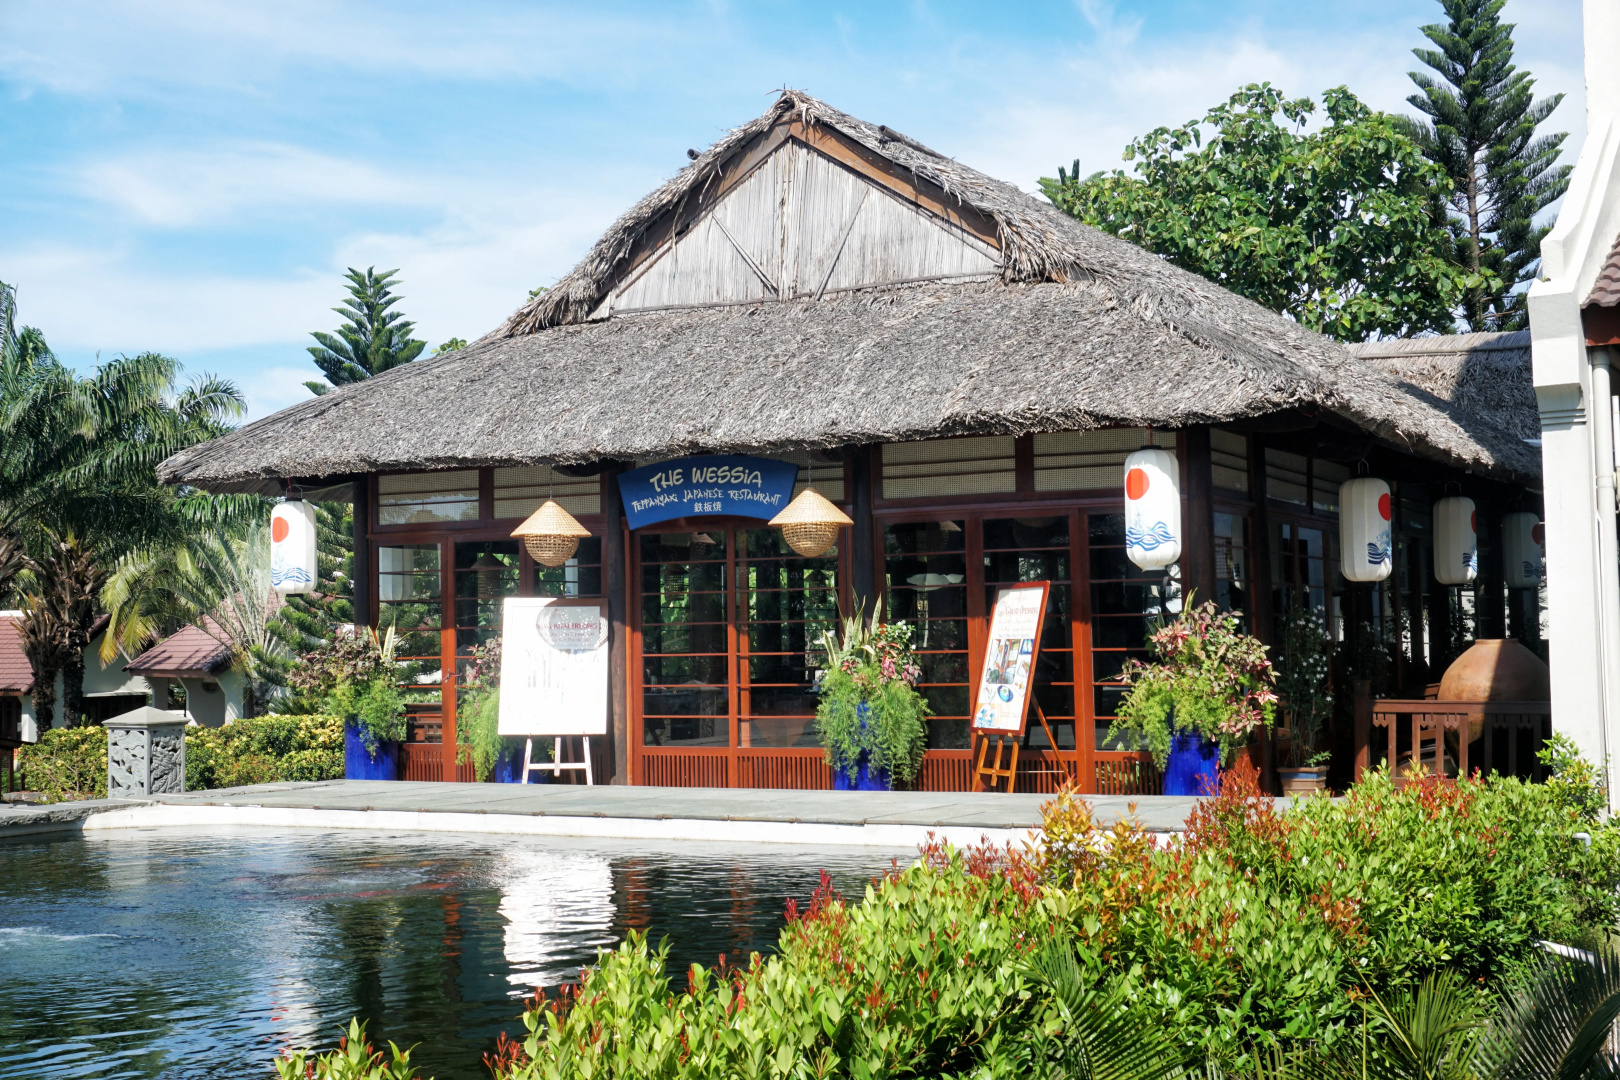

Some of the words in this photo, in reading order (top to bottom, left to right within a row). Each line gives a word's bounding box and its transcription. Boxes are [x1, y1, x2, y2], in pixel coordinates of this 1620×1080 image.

[650, 469, 684, 492] THE
[683, 488, 724, 502] JAPANESE
[728, 489, 782, 506] RESTAURANT
